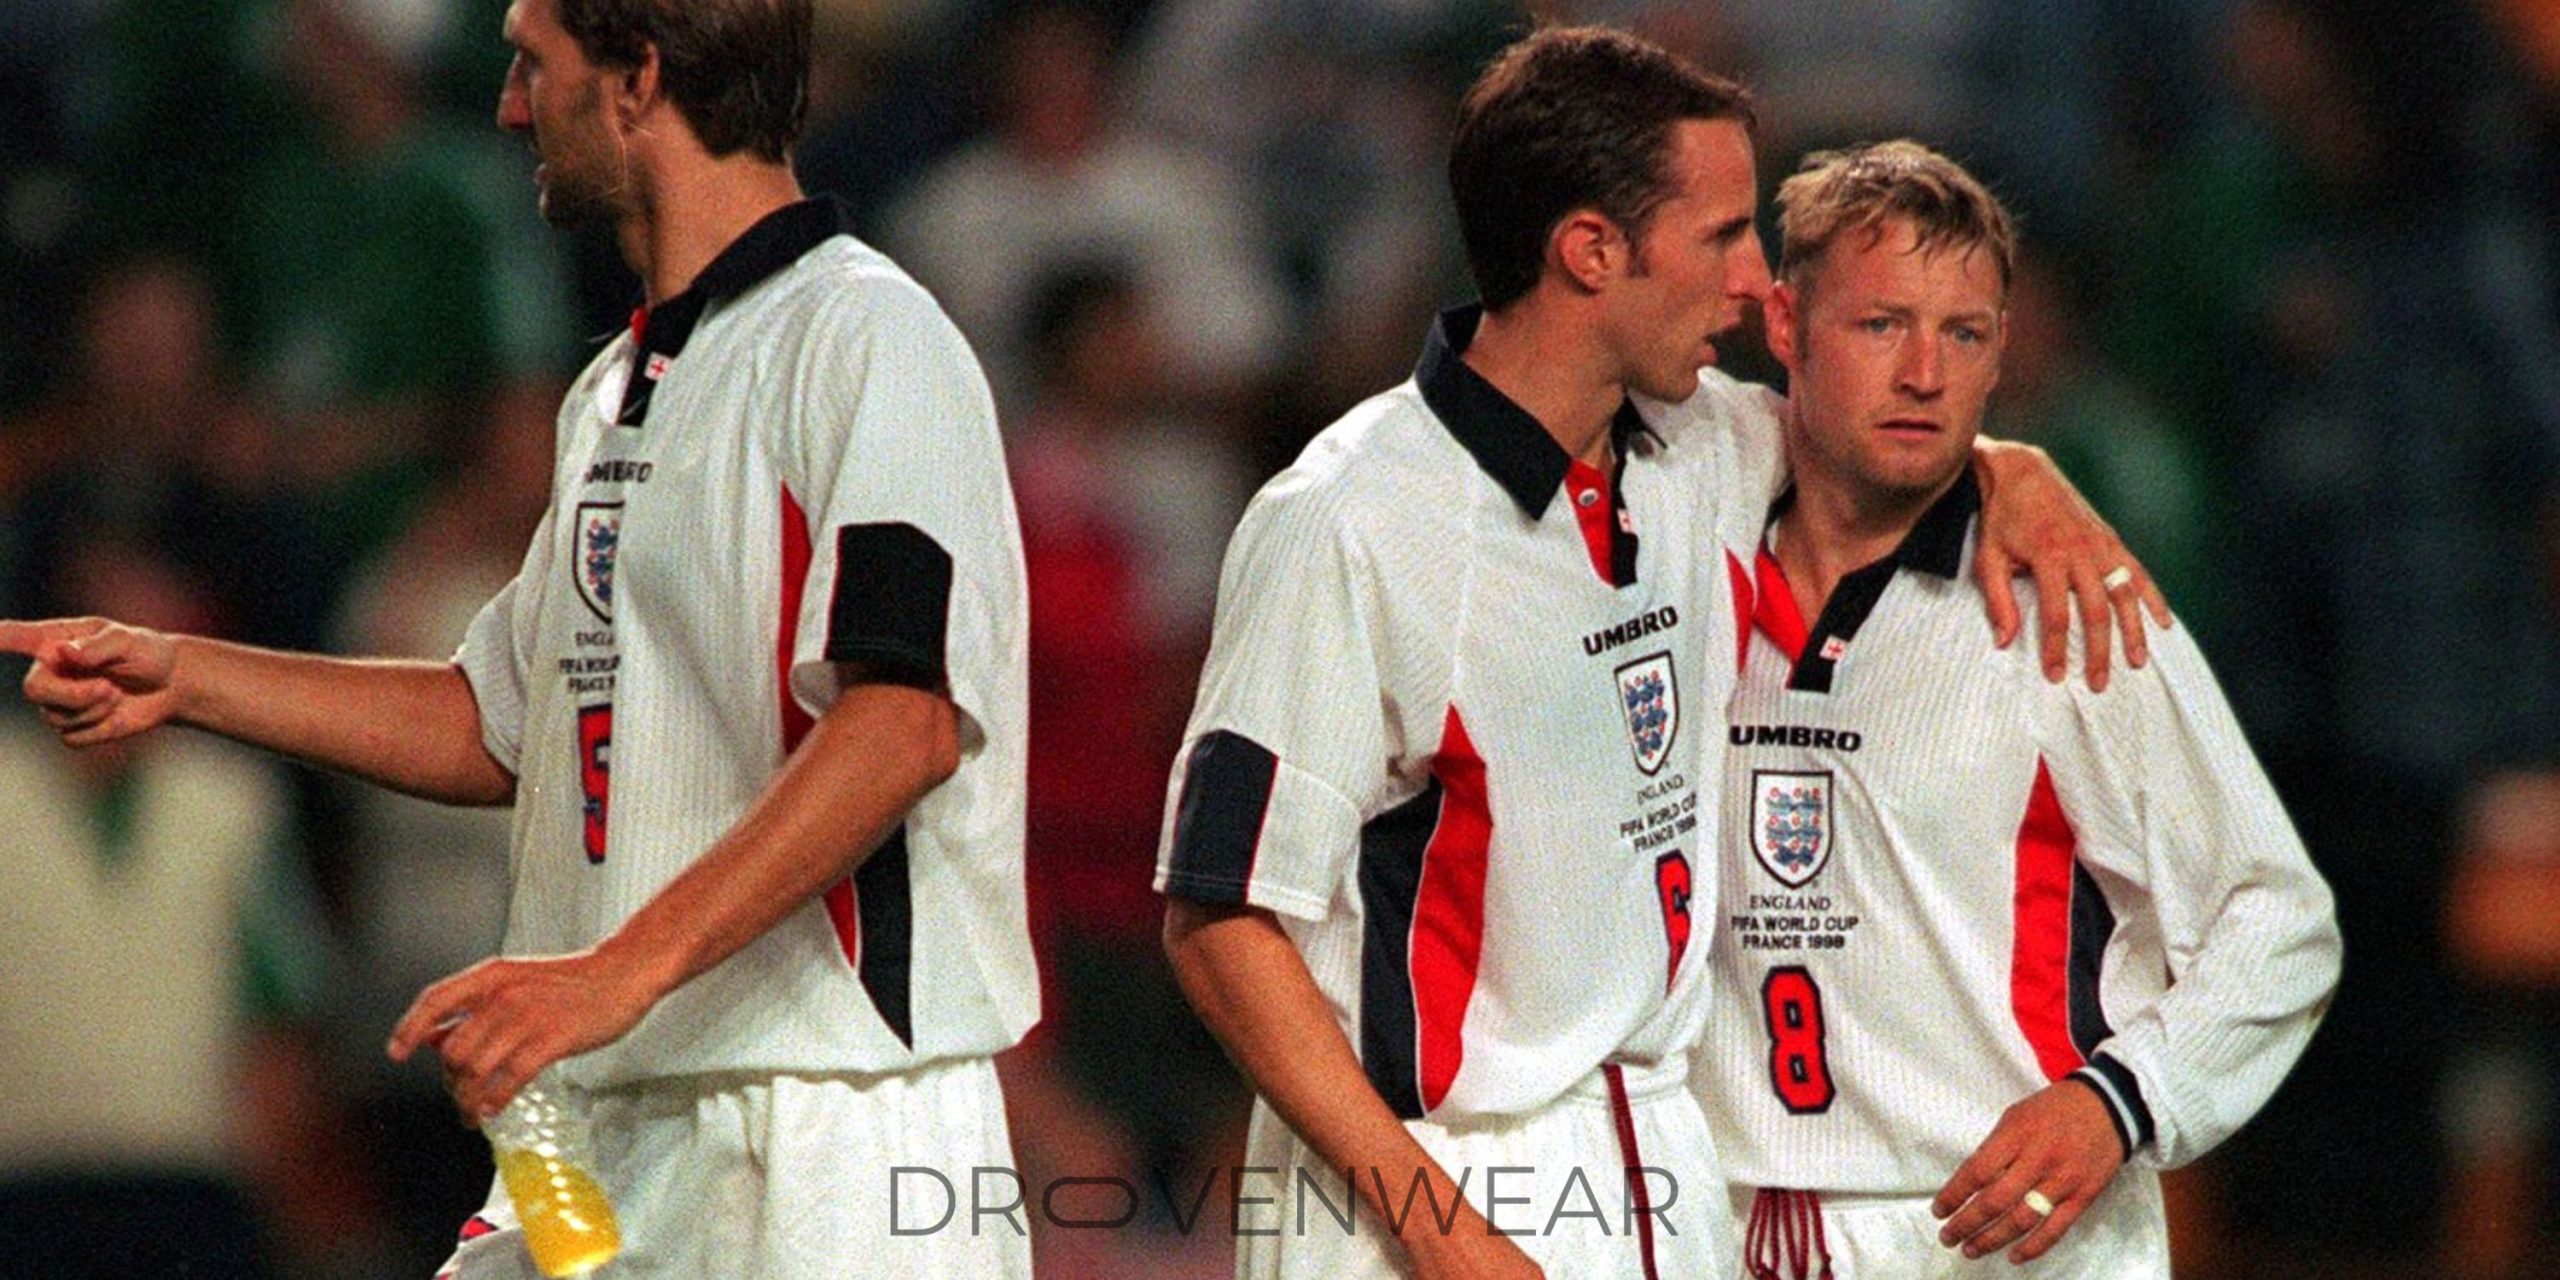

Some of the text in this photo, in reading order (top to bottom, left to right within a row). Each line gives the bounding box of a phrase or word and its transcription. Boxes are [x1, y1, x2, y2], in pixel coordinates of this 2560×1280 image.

[1583, 606, 1678, 656] UMBRO
[1729, 725, 1862, 752] UMBRO
[1637, 774, 1684, 805] ENGLAND
[1620, 819, 1645, 838] FIFA
[1647, 802, 1680, 829] WORLD
[1634, 825, 1674, 853] FRANCE
[1750, 895, 1831, 911] ENGLAND
[1731, 916, 1859, 932] FIFA WORLD CUP
[1743, 934, 1845, 950] FRANCE 1998
[1761, 965, 1836, 1115] 8
